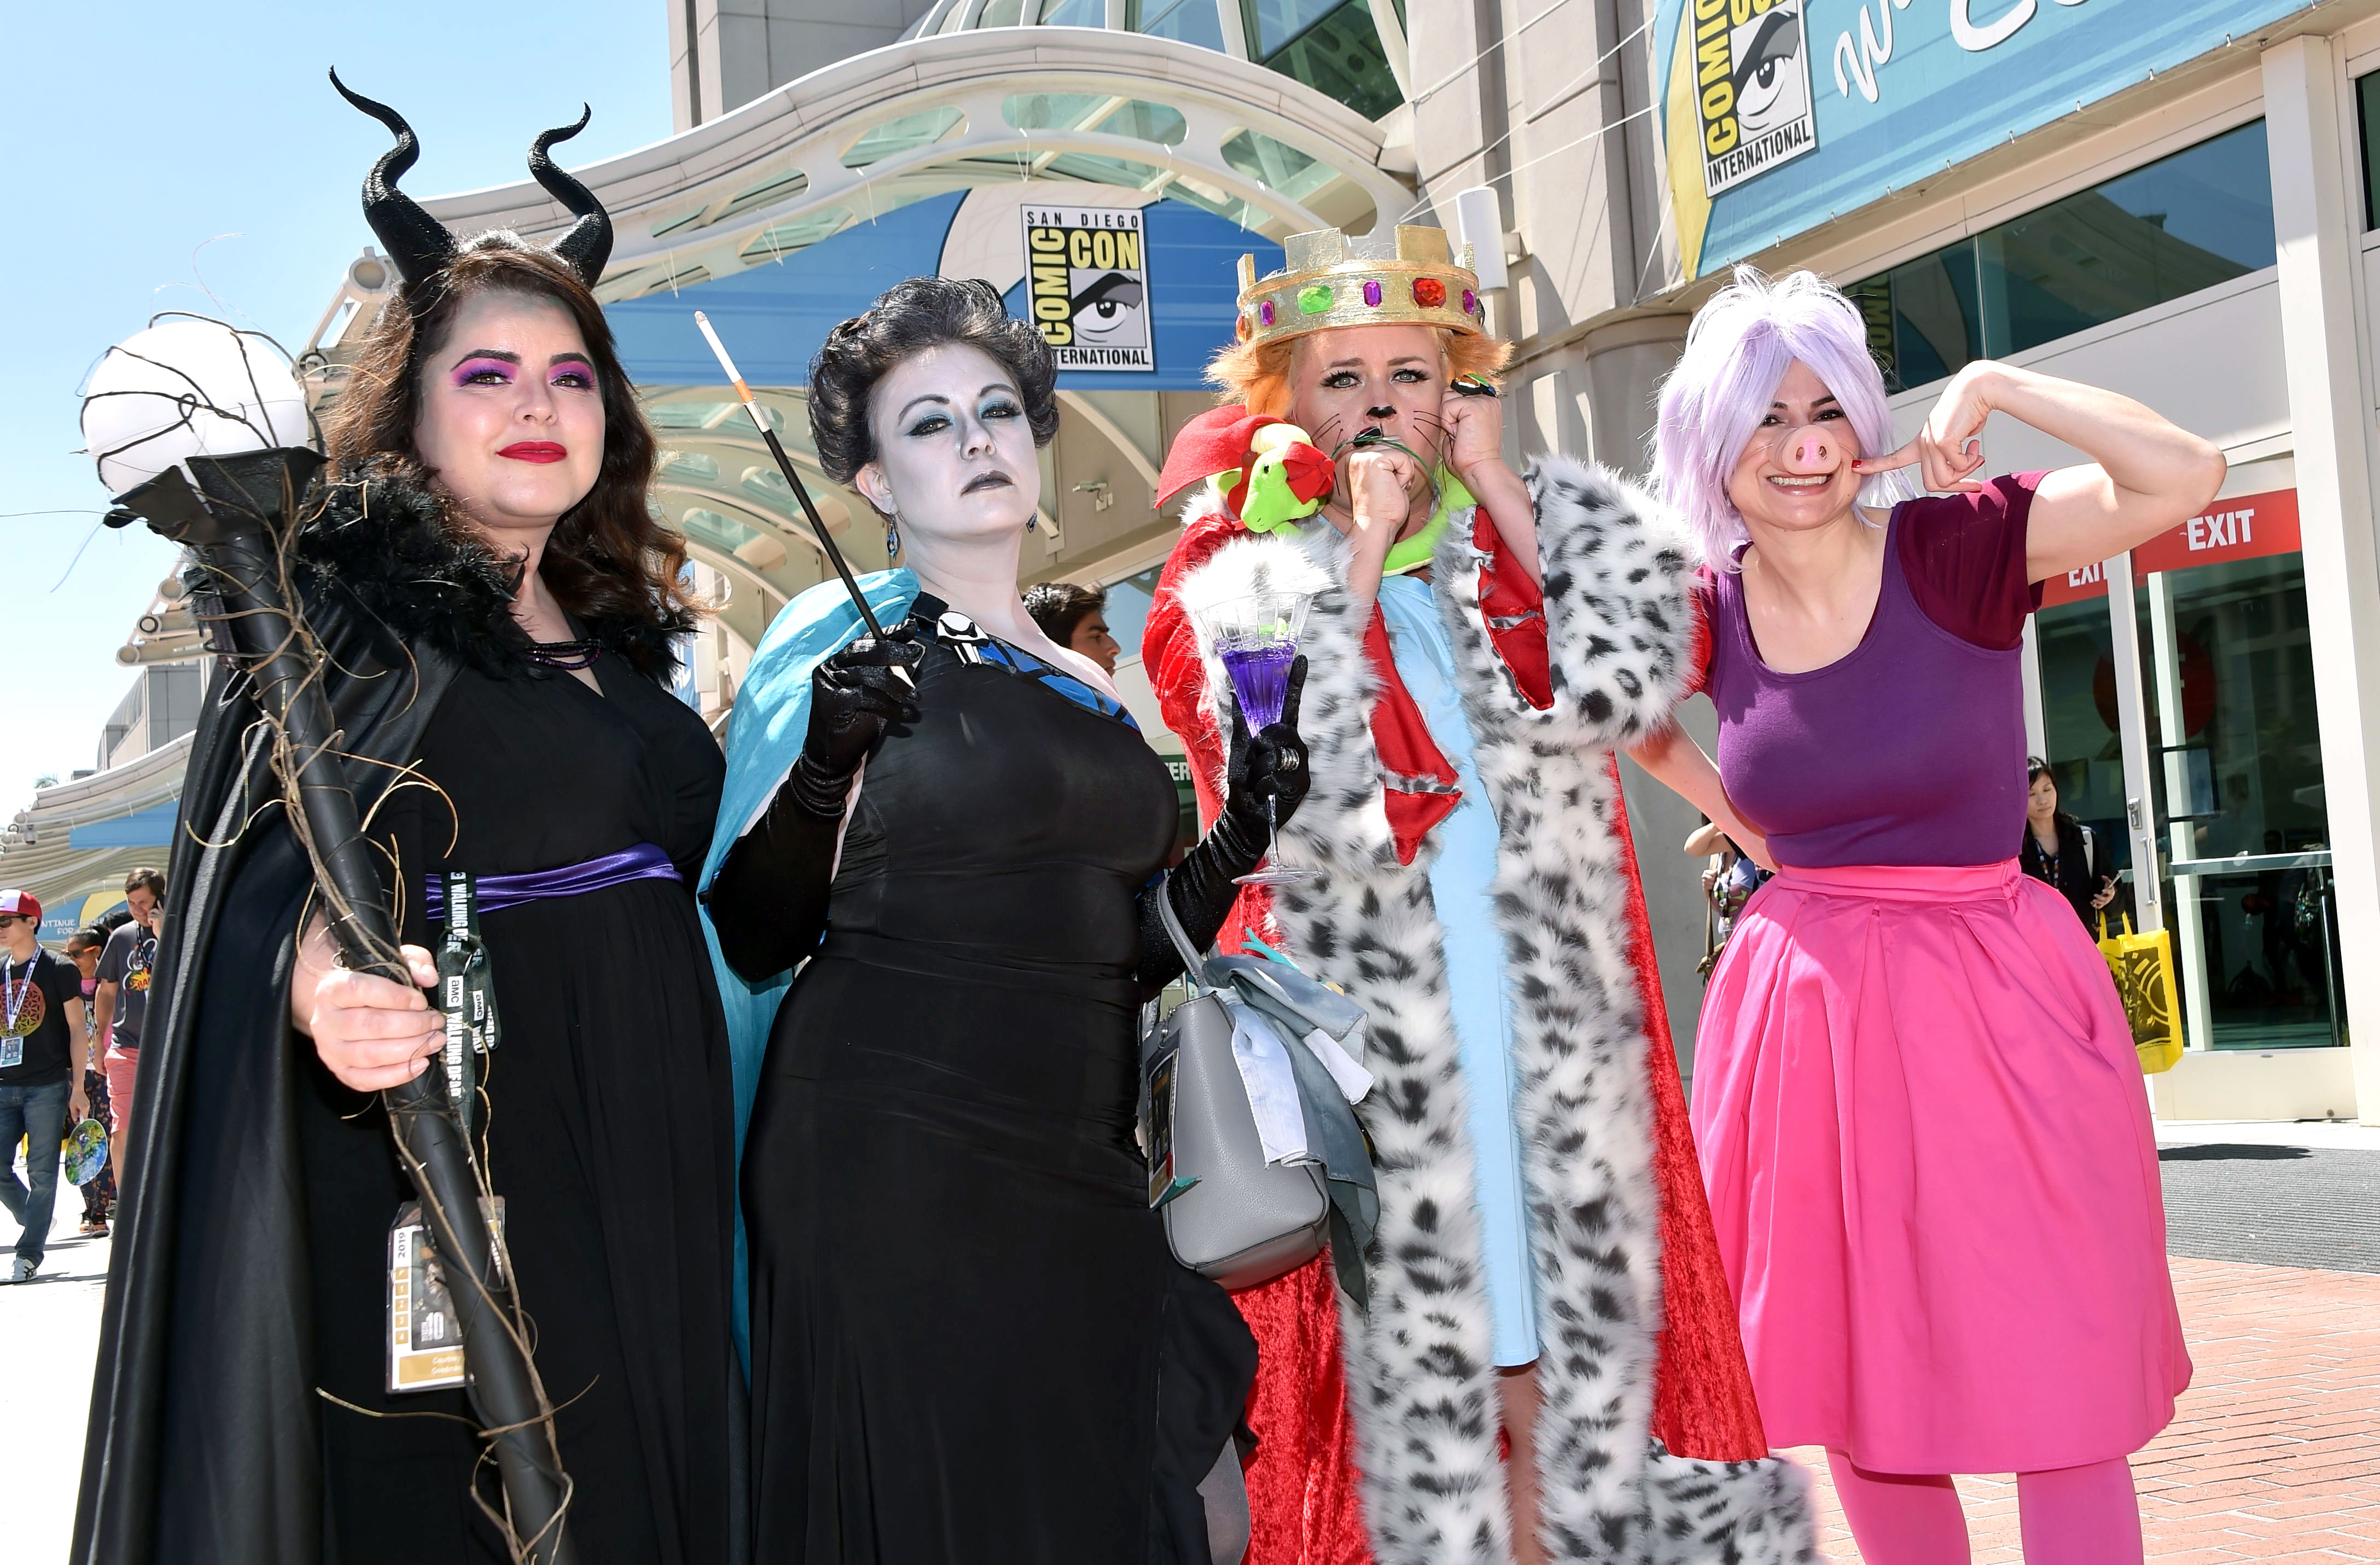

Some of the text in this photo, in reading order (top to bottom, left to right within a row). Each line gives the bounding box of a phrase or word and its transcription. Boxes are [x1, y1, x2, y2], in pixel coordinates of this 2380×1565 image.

[1708, 120, 1811, 187] INTERNATIONAL
[1027, 211, 1138, 228] SAN DIEGO
[1069, 230, 1140, 270] CON
[1031, 228, 1072, 346] COMIC
[1053, 348, 1149, 365] TERNATIONAL
[2187, 508, 2254, 551] EXIT
[41, 919, 76, 928] NTINUE
[451, 883, 468, 927] WALKING
[446, 1011, 463, 1065] WALKING
[398, 1232, 406, 1258] 2019
